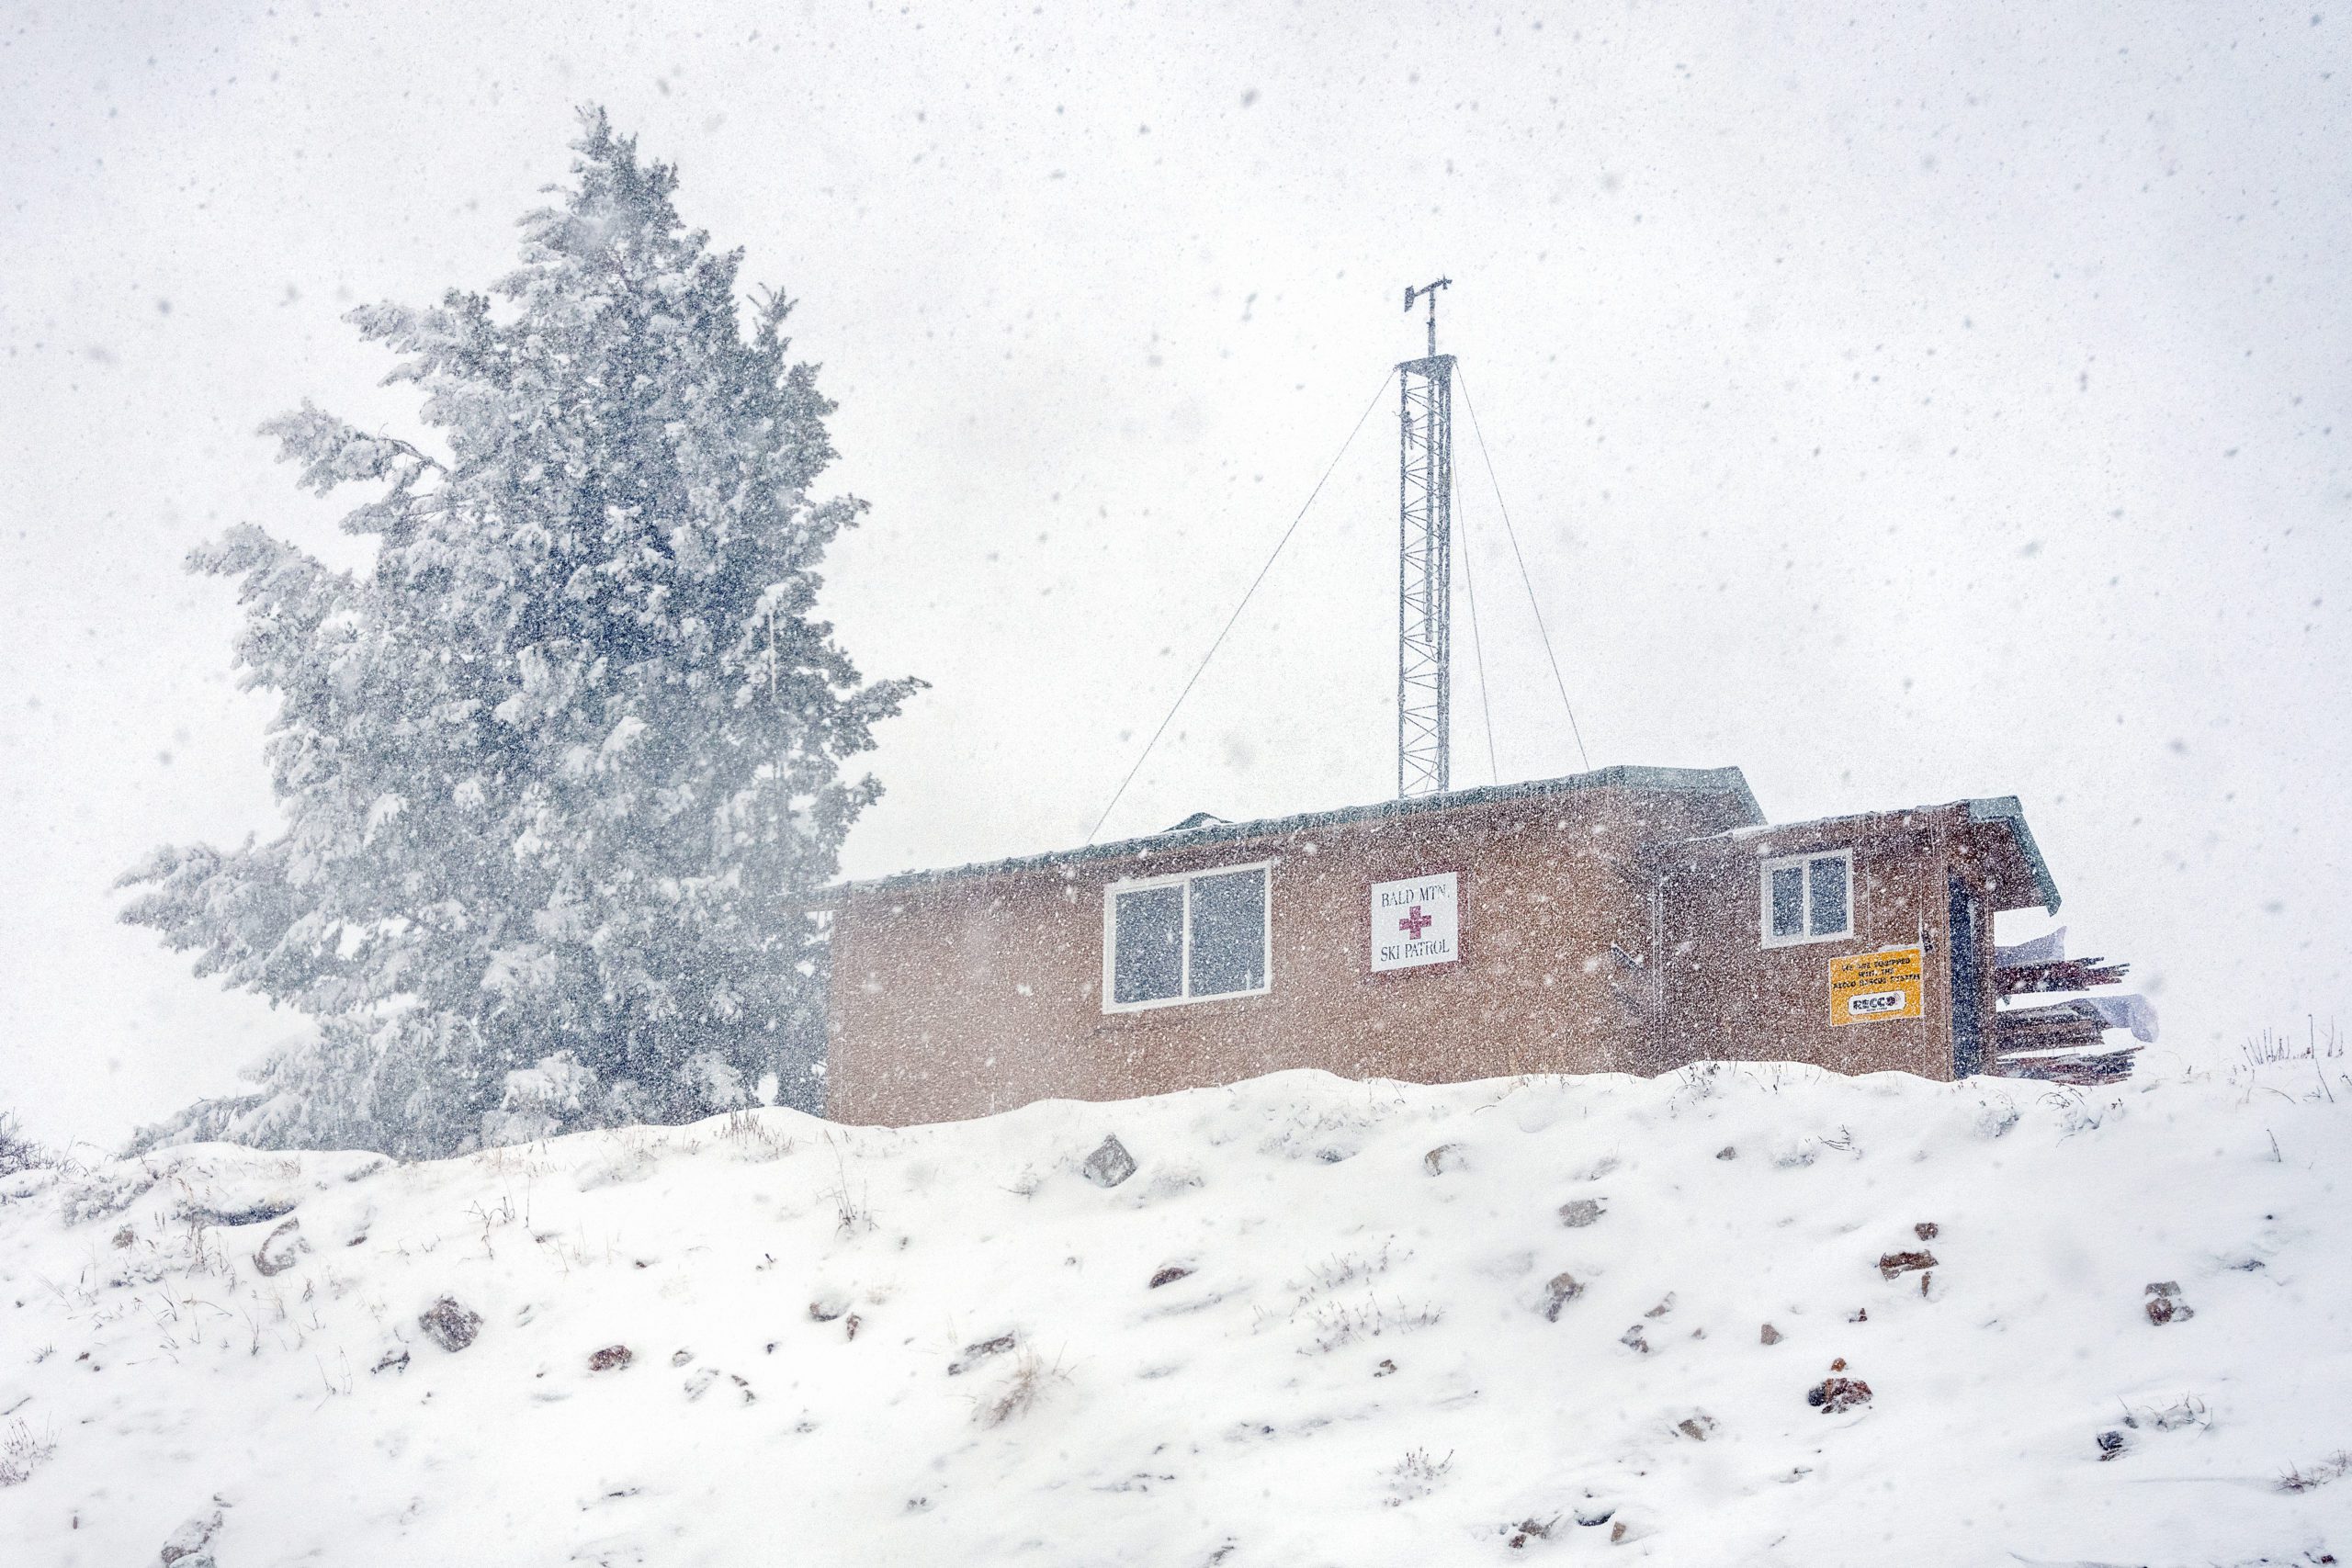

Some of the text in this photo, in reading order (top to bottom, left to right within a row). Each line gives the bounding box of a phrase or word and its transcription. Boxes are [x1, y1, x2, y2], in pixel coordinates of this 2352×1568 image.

[1381, 888, 1413, 907] BALD
[1380, 939, 1450, 963] SKI PATROL
[1852, 996, 1896, 1010] RECCO
